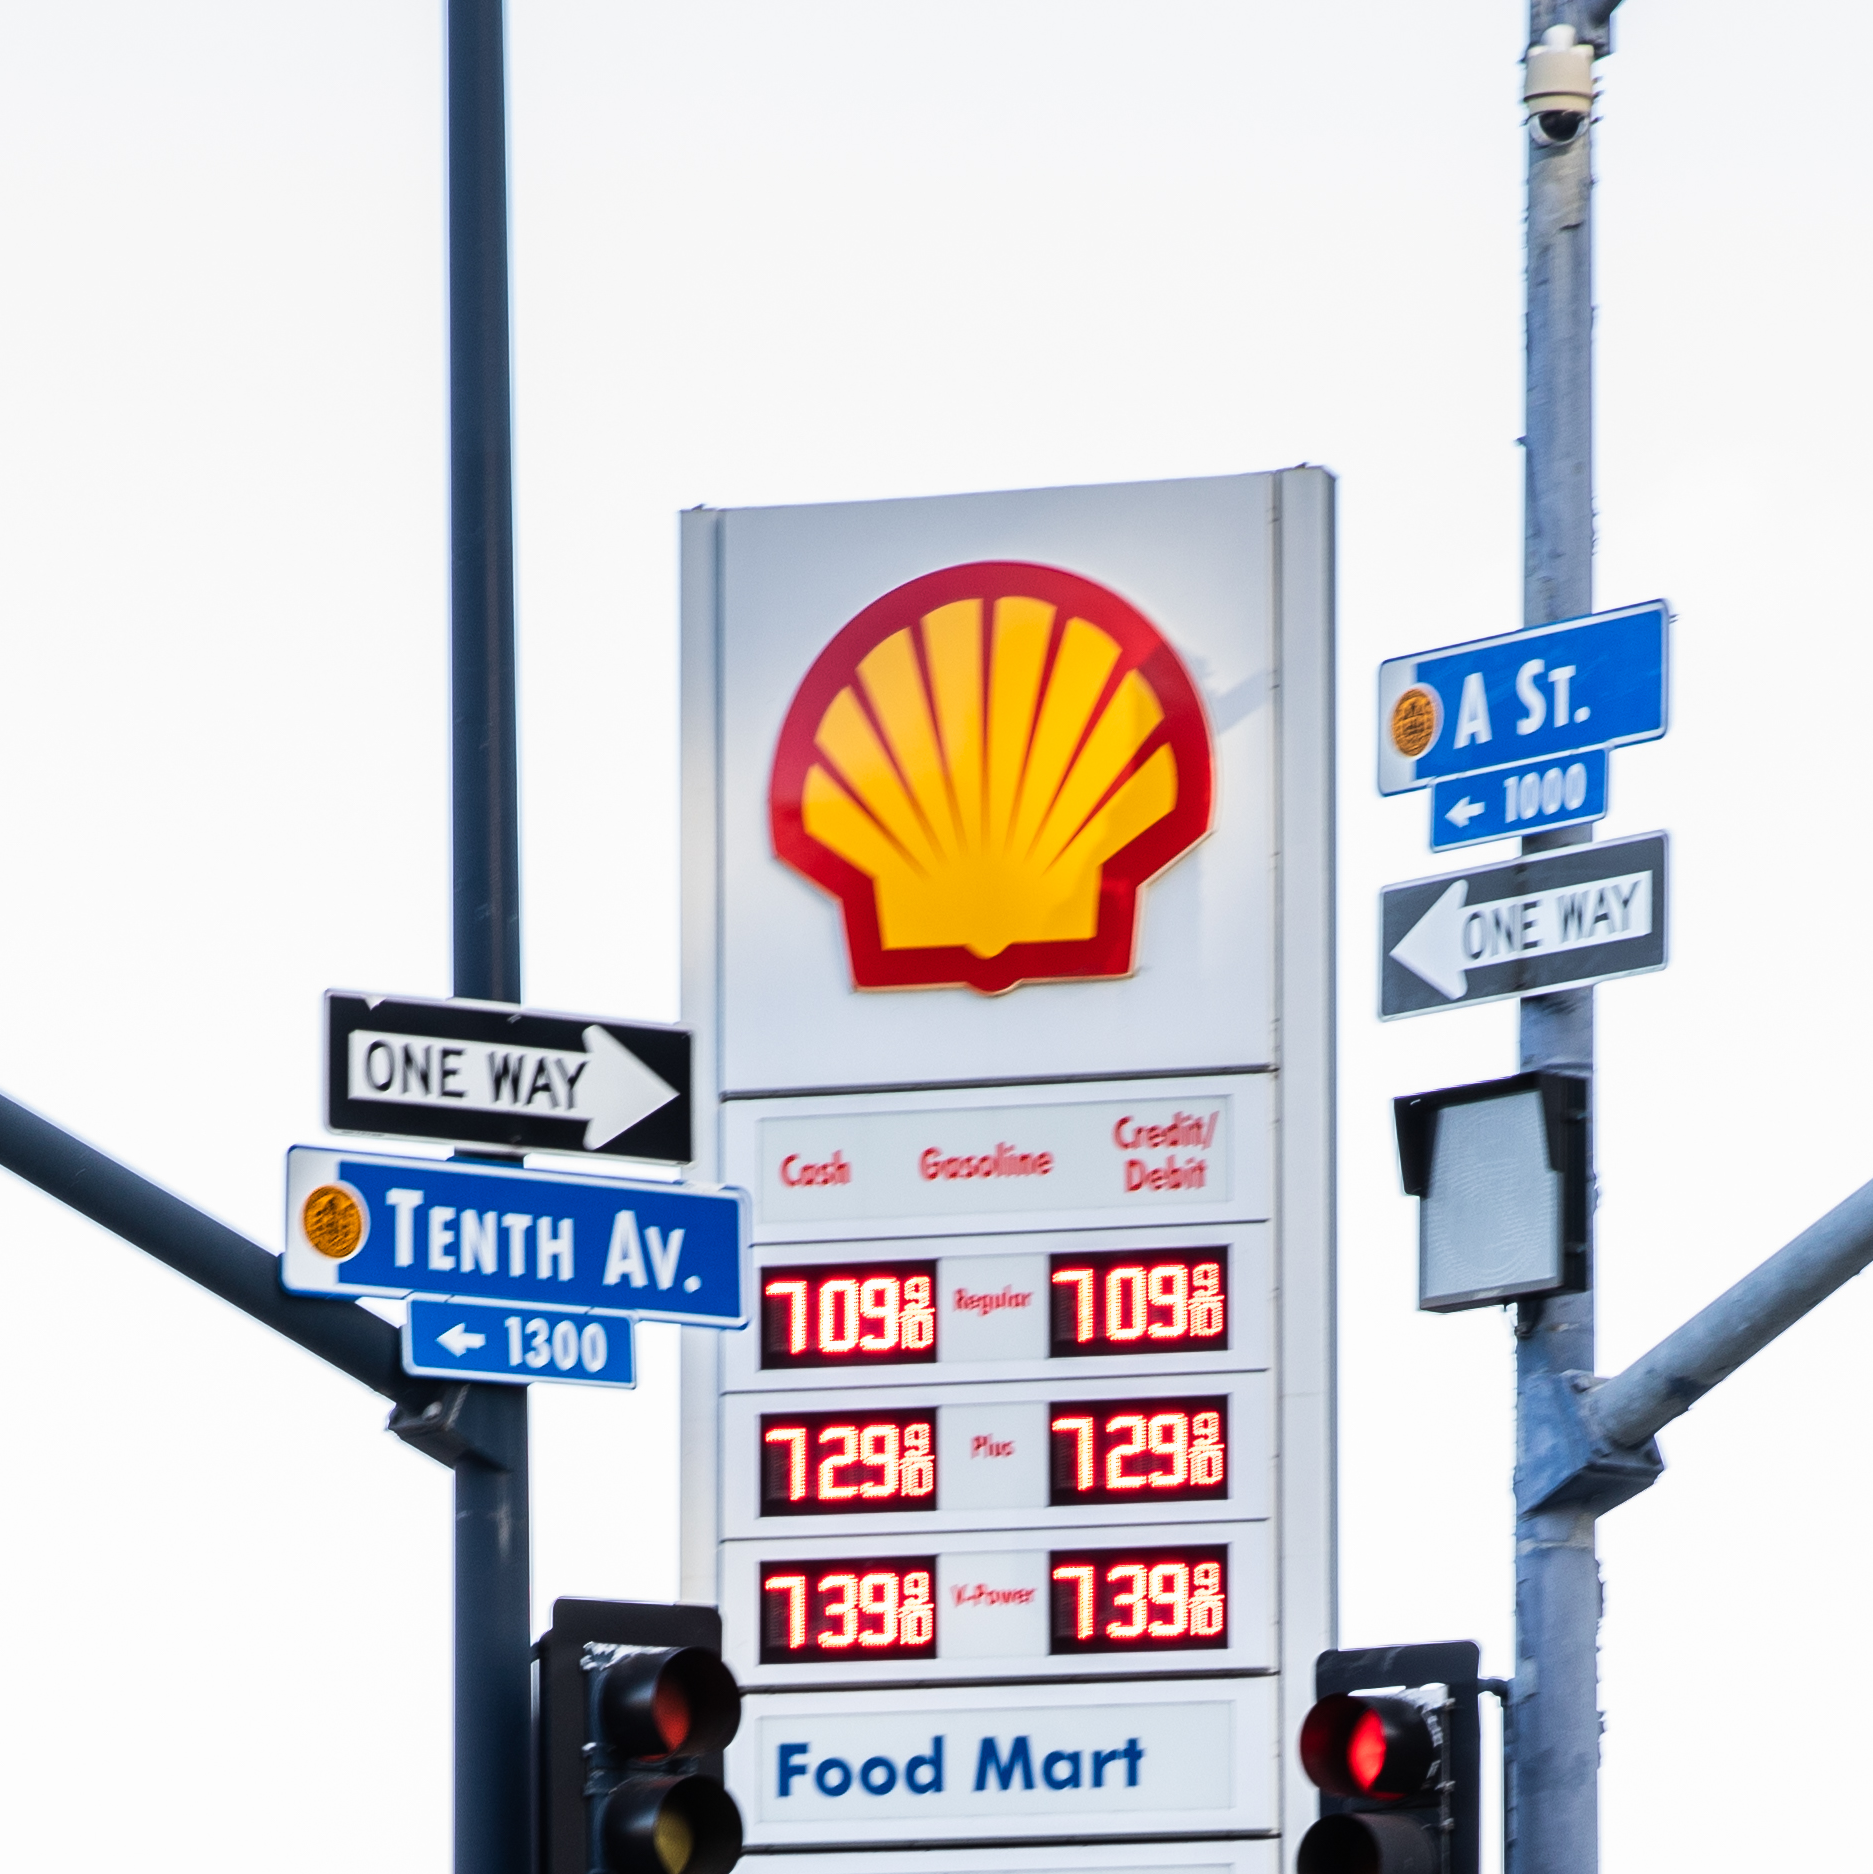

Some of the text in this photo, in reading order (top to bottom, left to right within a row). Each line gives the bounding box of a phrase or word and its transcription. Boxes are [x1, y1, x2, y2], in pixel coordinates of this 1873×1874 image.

[1453, 672, 1492, 750] A
[1503, 762, 1587, 824] 1000
[1461, 878, 1643, 961] ONE WAY
[366, 1040, 590, 1111] ONE WAY
[1113, 1111, 1220, 1150] Credit/
[780, 1149, 851, 1186] Cash
[919, 1142, 1054, 1181] Gasoline
[1124, 1156, 1209, 1193] Debit
[953, 1286, 1032, 1316] Regular
[504, 1315, 608, 1373] 1300
[971, 1434, 1015, 1459] Plus
[950, 1583, 1036, 1608] V-Power
[776, 1735, 1144, 1798] Food Mart
